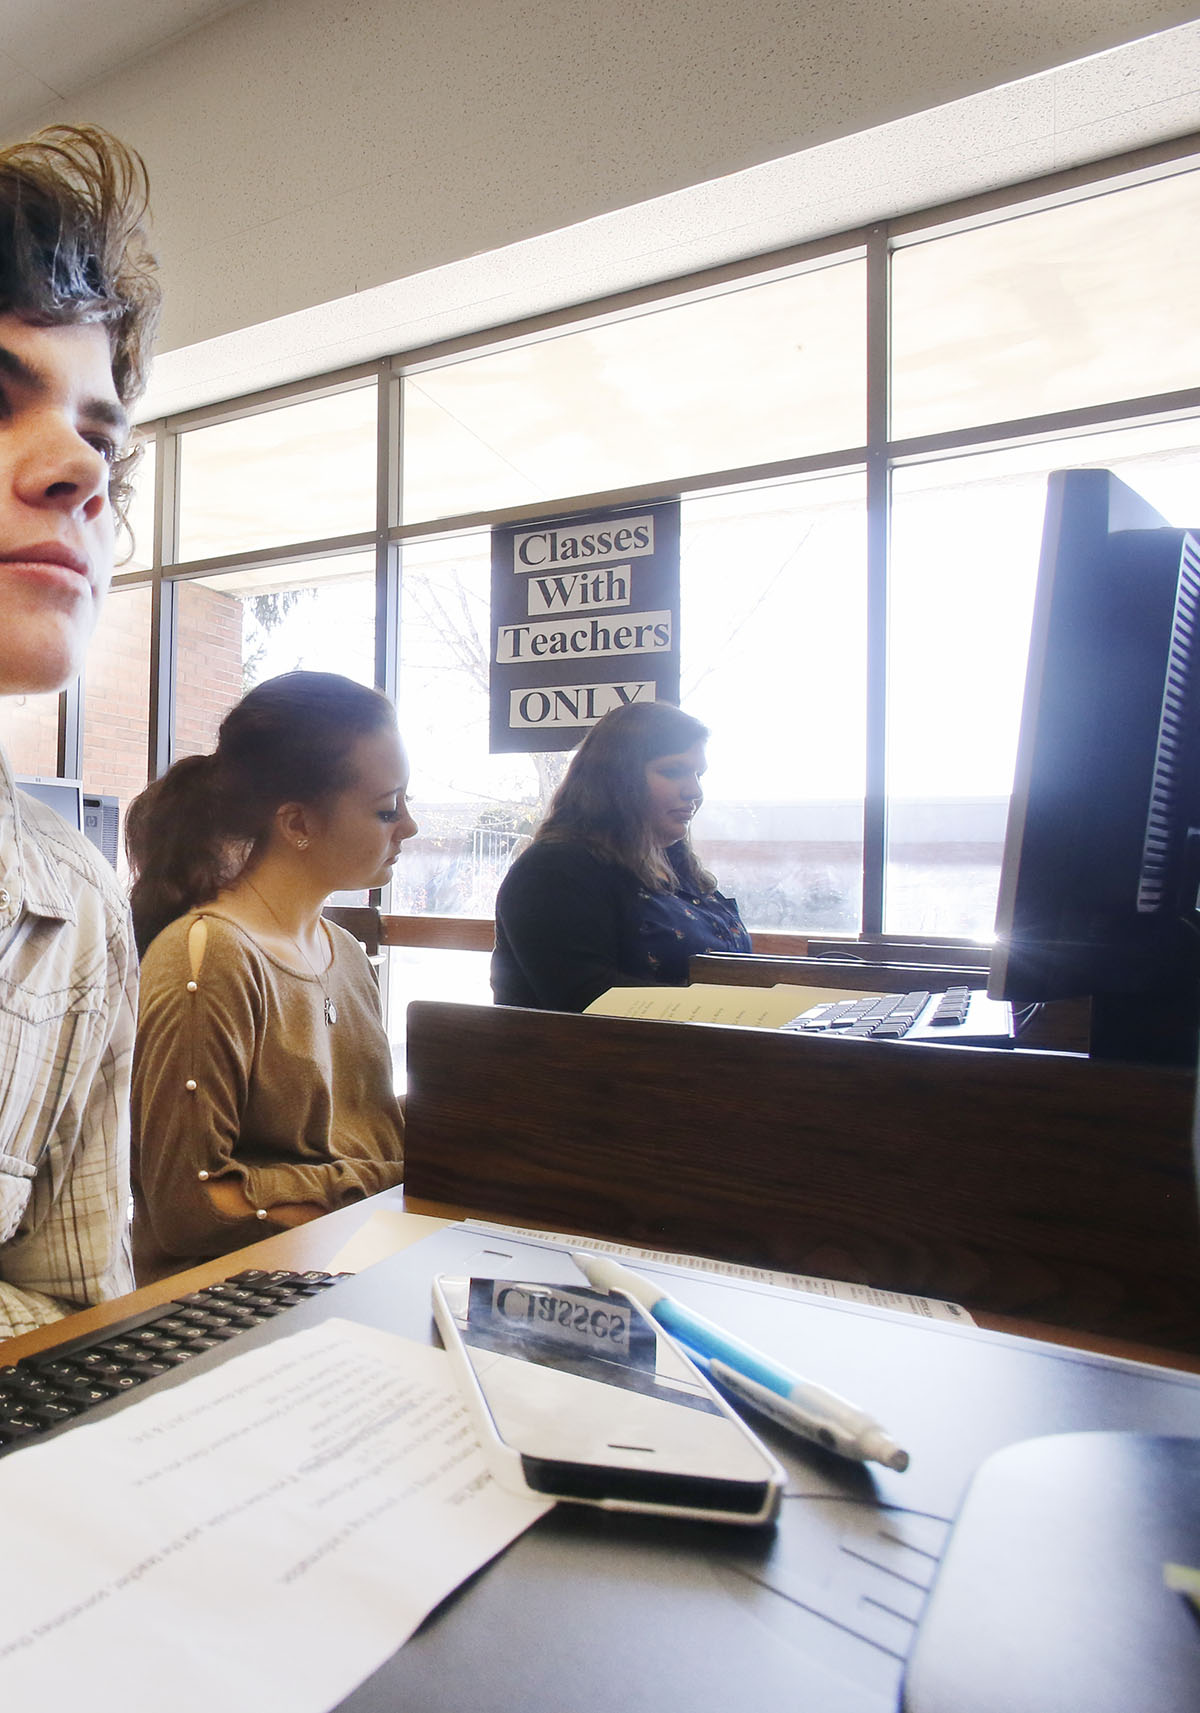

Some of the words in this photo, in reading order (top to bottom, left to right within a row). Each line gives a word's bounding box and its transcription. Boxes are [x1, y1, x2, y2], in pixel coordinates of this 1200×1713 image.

[518, 526, 650, 566] Classes
[536, 570, 627, 609] With
[503, 620, 670, 658] Teachers
[119, 1377, 134, 1386] O
